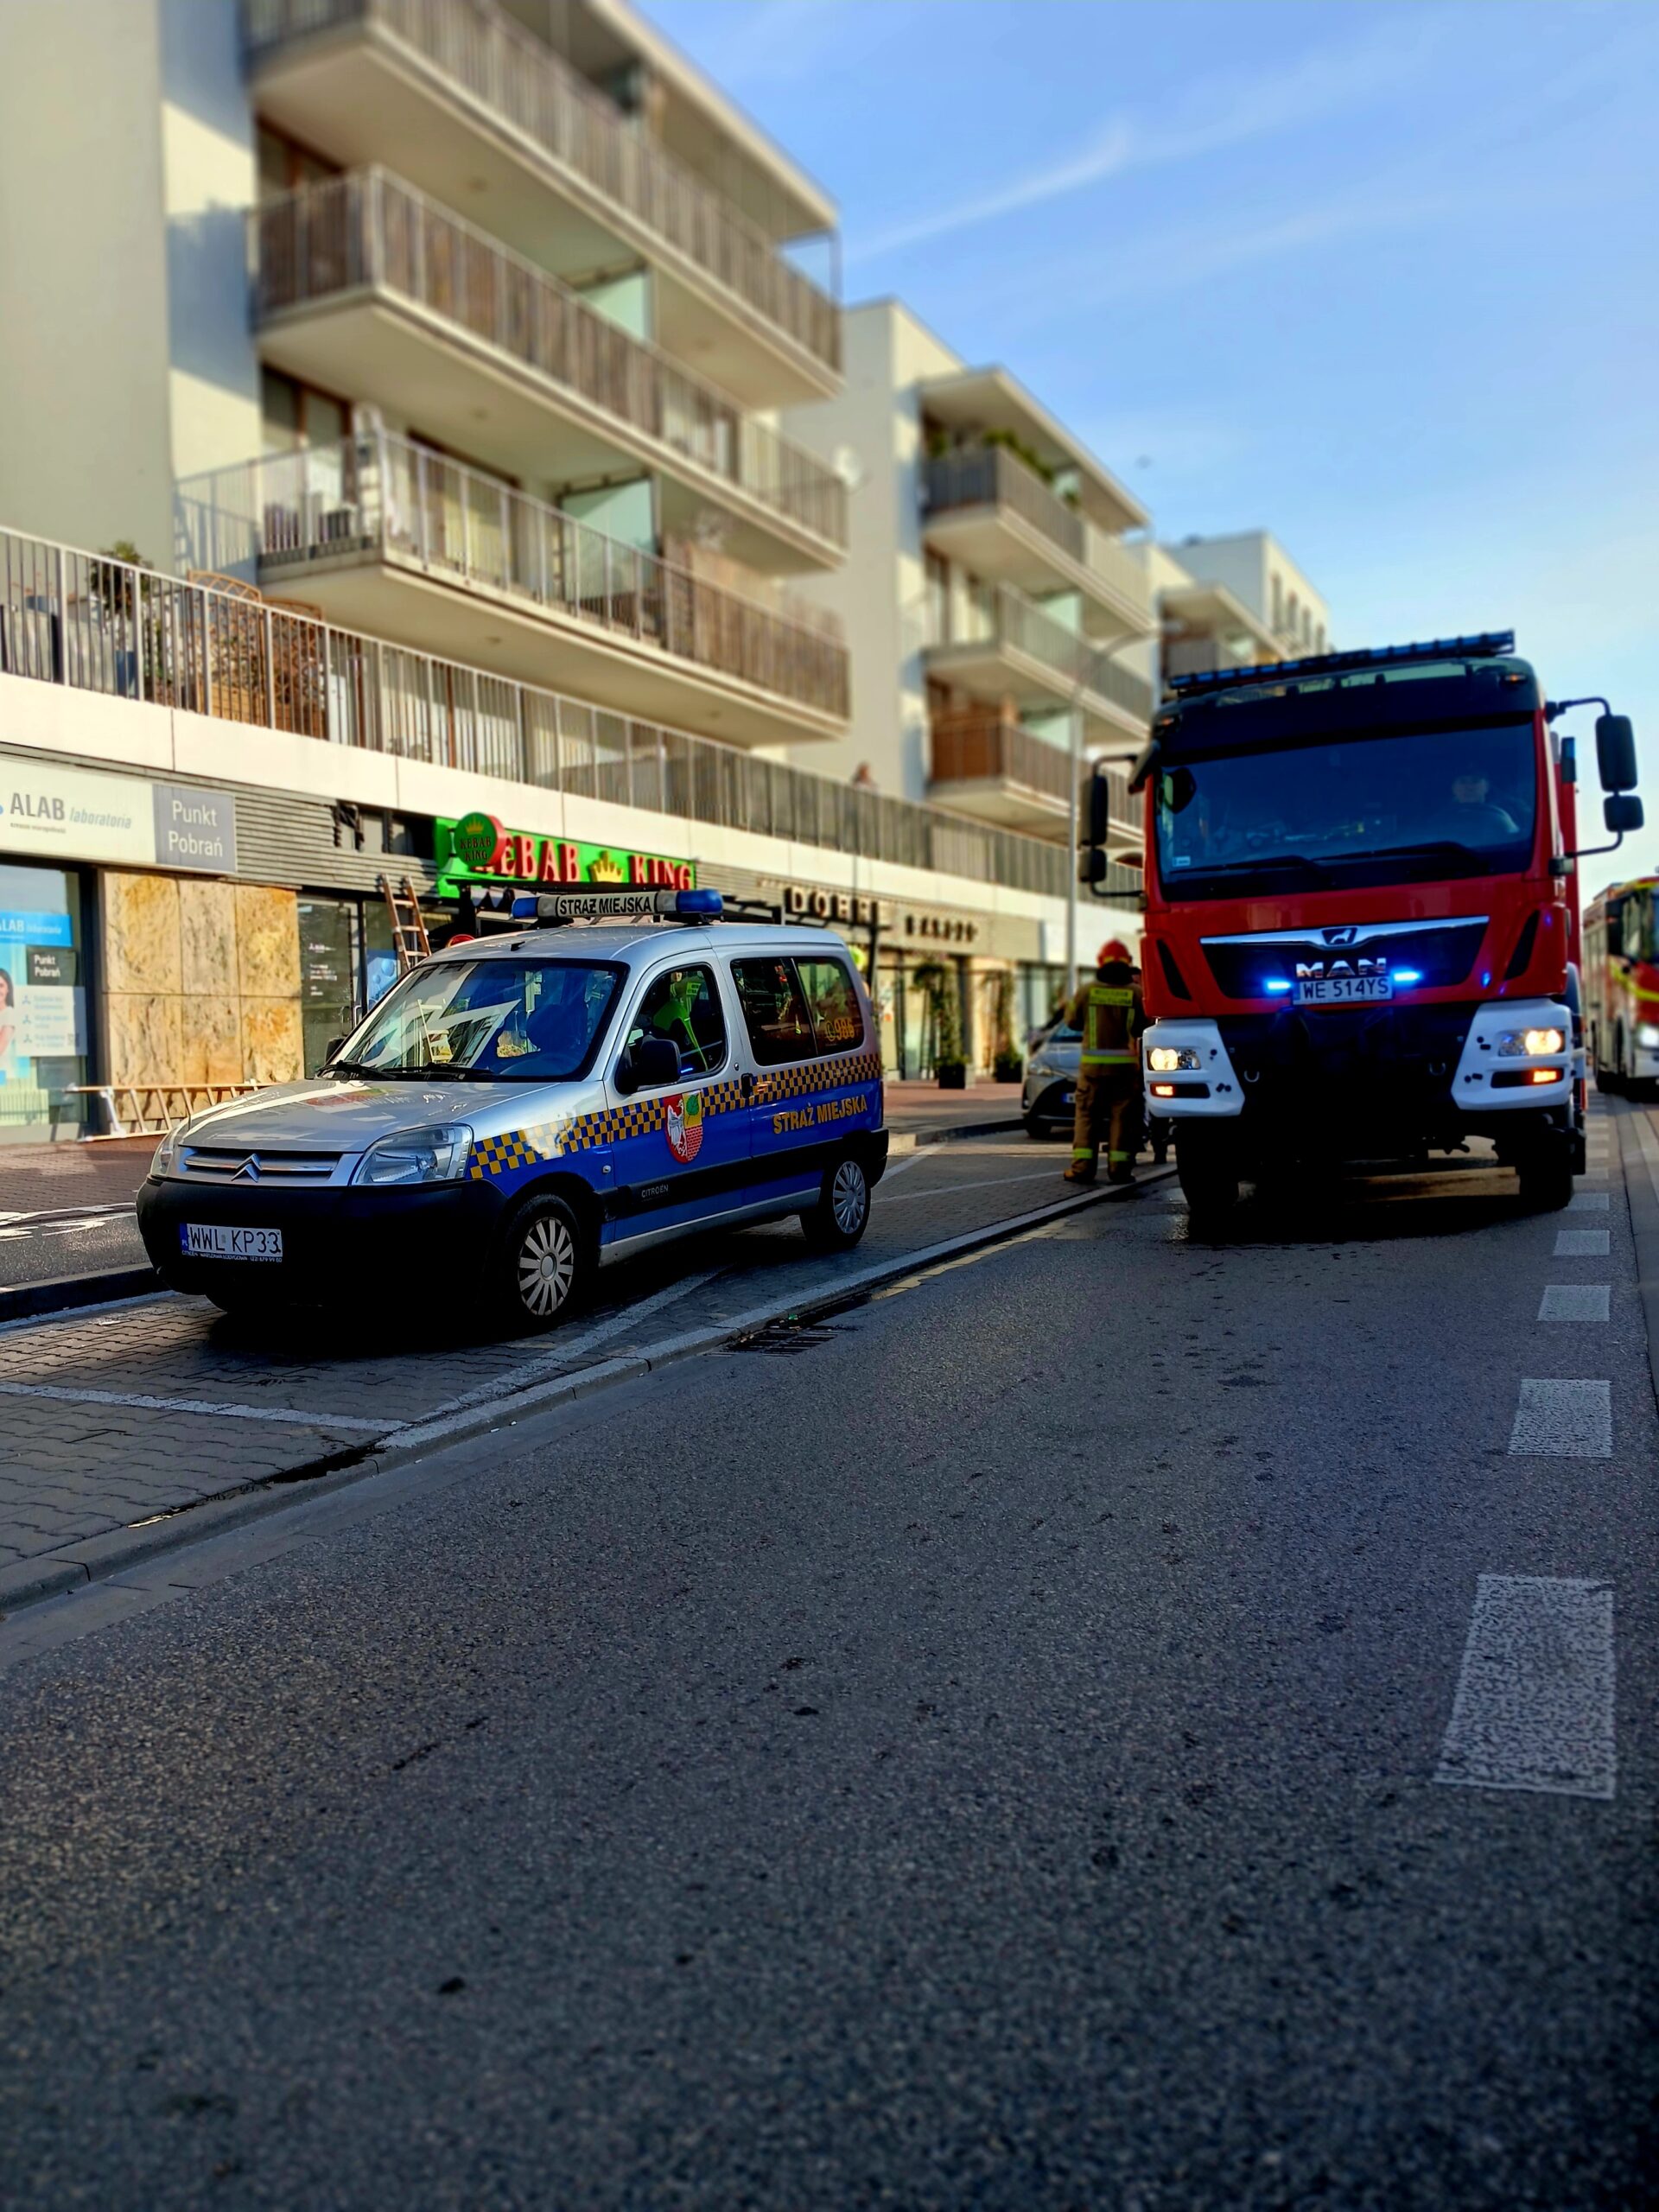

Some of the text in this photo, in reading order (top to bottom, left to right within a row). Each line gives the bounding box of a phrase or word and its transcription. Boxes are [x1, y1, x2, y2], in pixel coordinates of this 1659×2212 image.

[10, 792, 65, 821] ALAB
[70, 807, 132, 830] laboratoria
[172, 800, 218, 827] Punkt
[168, 830, 223, 857] Pobrań
[460, 836, 492, 849] KEBAB
[465, 850, 487, 862] KING
[473, 832, 693, 890] EBAB KING
[599, 895, 652, 913] MIEJSKA
[34, 954, 56, 965] Punkt
[1296, 957, 1387, 978] MAN
[1303, 978, 1389, 999] WE 514YS
[773, 1094, 868, 1135] STRAŻ MIEJSKA
[190, 1226, 281, 1254] WWL KP33
